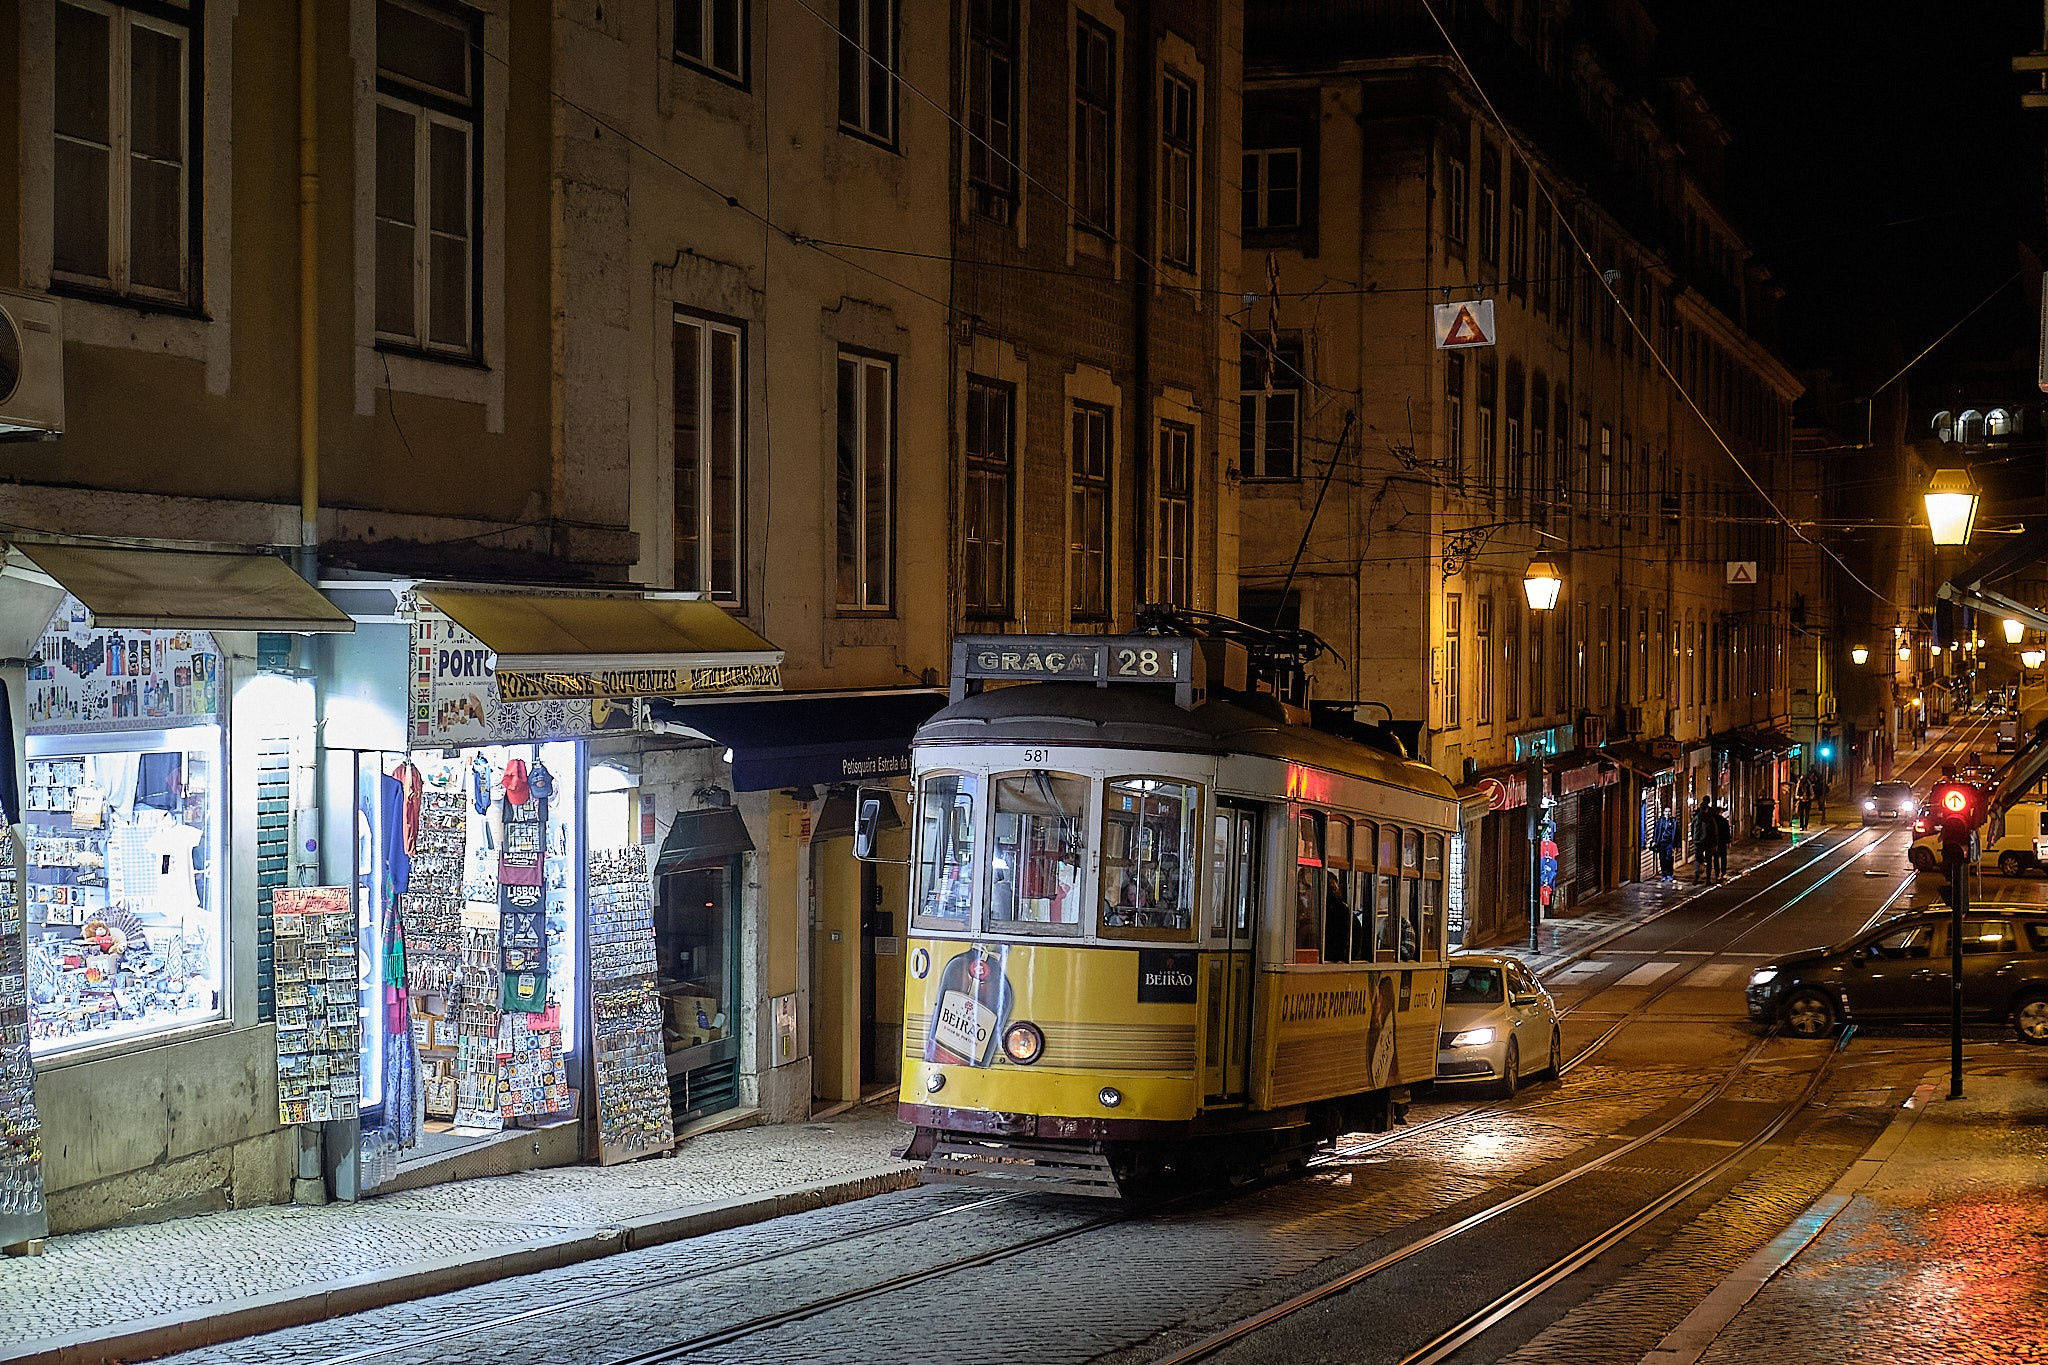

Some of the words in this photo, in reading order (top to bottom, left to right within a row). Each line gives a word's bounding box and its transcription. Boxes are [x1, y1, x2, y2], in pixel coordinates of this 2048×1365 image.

[978, 651, 1087, 673] GRAÇA
[1118, 649, 1160, 676] 28
[497, 671, 594, 699] PORTUGUESE
[601, 669, 677, 694] SOUVENIRS
[690, 665, 780, 690] MINIMERCADO
[1657, 742, 1677, 750] ATM
[1023, 749, 1049, 762] 581
[842, 757, 876, 777] Petisqueira
[878, 755, 899, 772] Estrela
[900, 755, 908, 770] da
[277, 890, 290, 901] WE
[293, 889, 317, 900] HAVE
[507, 885, 541, 898] LISBOA
[277, 901, 301, 911] MORE
[1145, 973, 1193, 986] BEIRÃO
[1282, 994, 1289, 1022] O
[1290, 992, 1316, 1021] LICOR
[1316, 991, 1328, 1019] DE
[1328, 990, 1367, 1018] PORTUGAL
[942, 1008, 986, 1041] BEIRÃO
